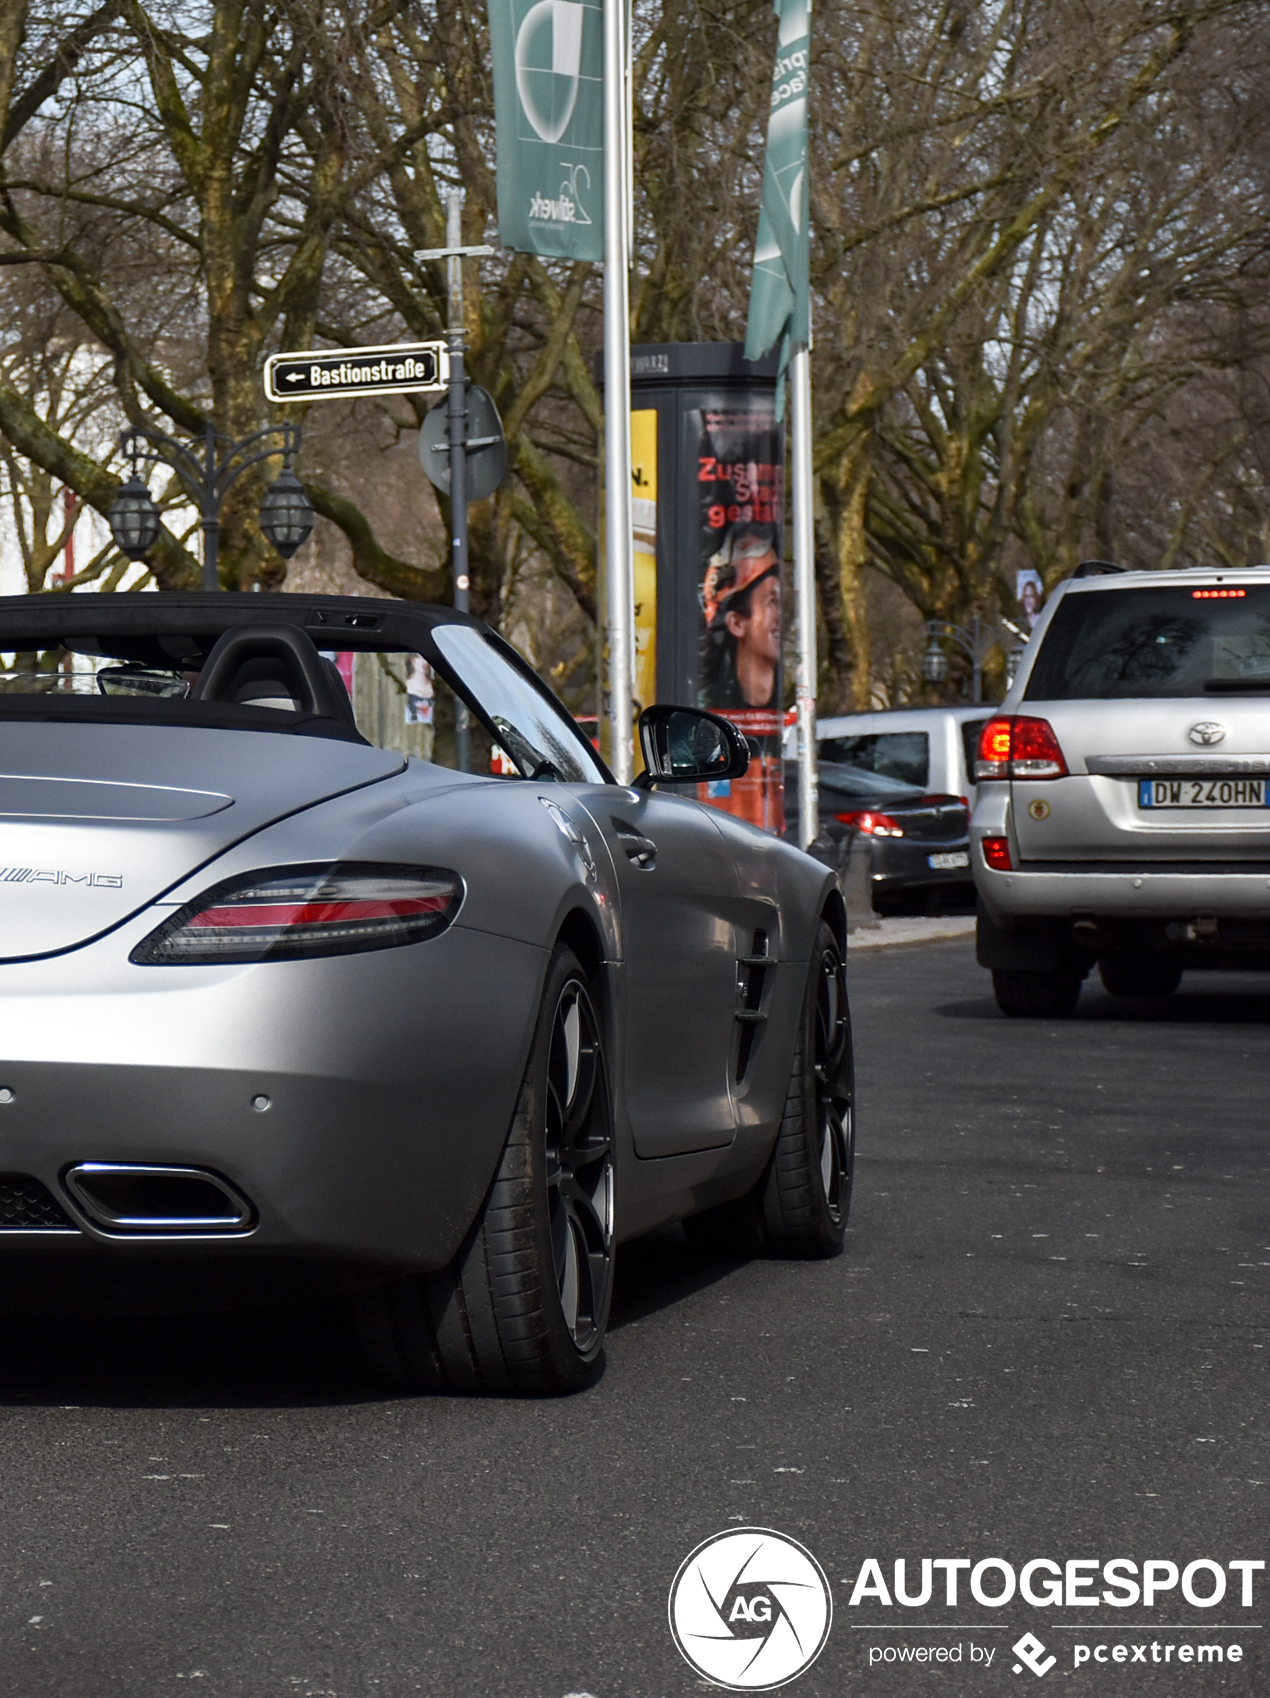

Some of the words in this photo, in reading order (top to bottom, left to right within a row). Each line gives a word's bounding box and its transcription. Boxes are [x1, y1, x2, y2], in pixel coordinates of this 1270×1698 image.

[310, 358, 425, 387] Bastionstraße
[1154, 781, 1181, 804] DW
[1190, 781, 1263, 804] 240HN
[27, 869, 123, 888] AMG
